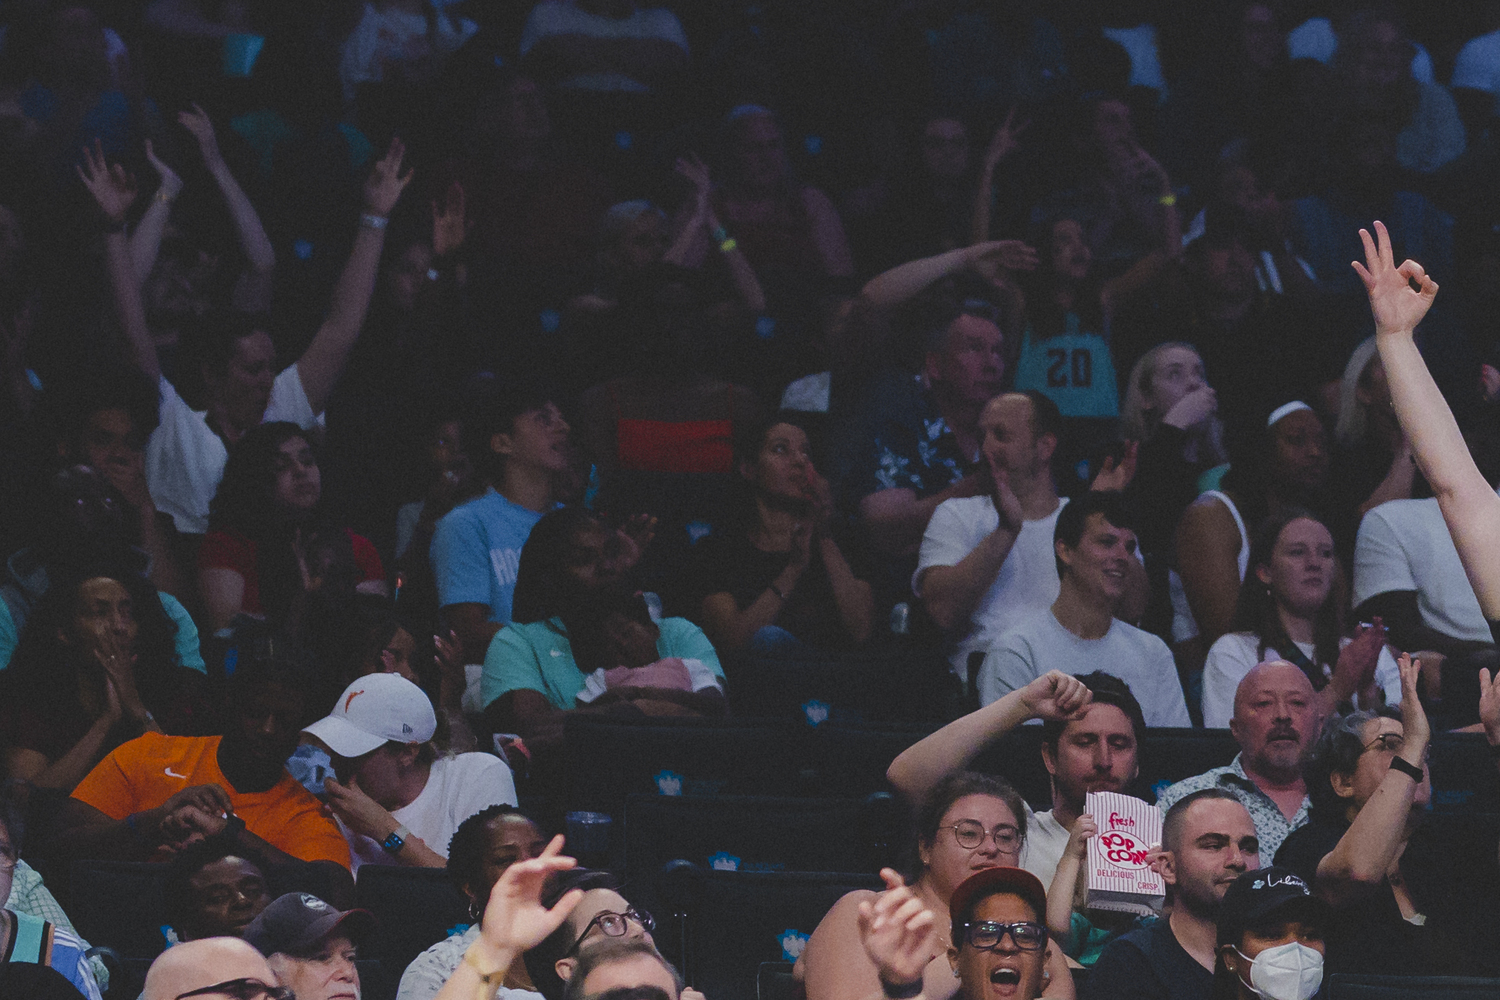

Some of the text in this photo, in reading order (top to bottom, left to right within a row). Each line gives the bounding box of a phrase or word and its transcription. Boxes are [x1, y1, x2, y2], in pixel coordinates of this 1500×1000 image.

[1047, 348, 1092, 387] 20
[1109, 812, 1135, 829] fresh
[1101, 833, 1134, 851] POP
[1107, 850, 1147, 865] CORN
[1097, 868, 1135, 880] DELICIOUS
[1138, 881, 1158, 891] CRISP
